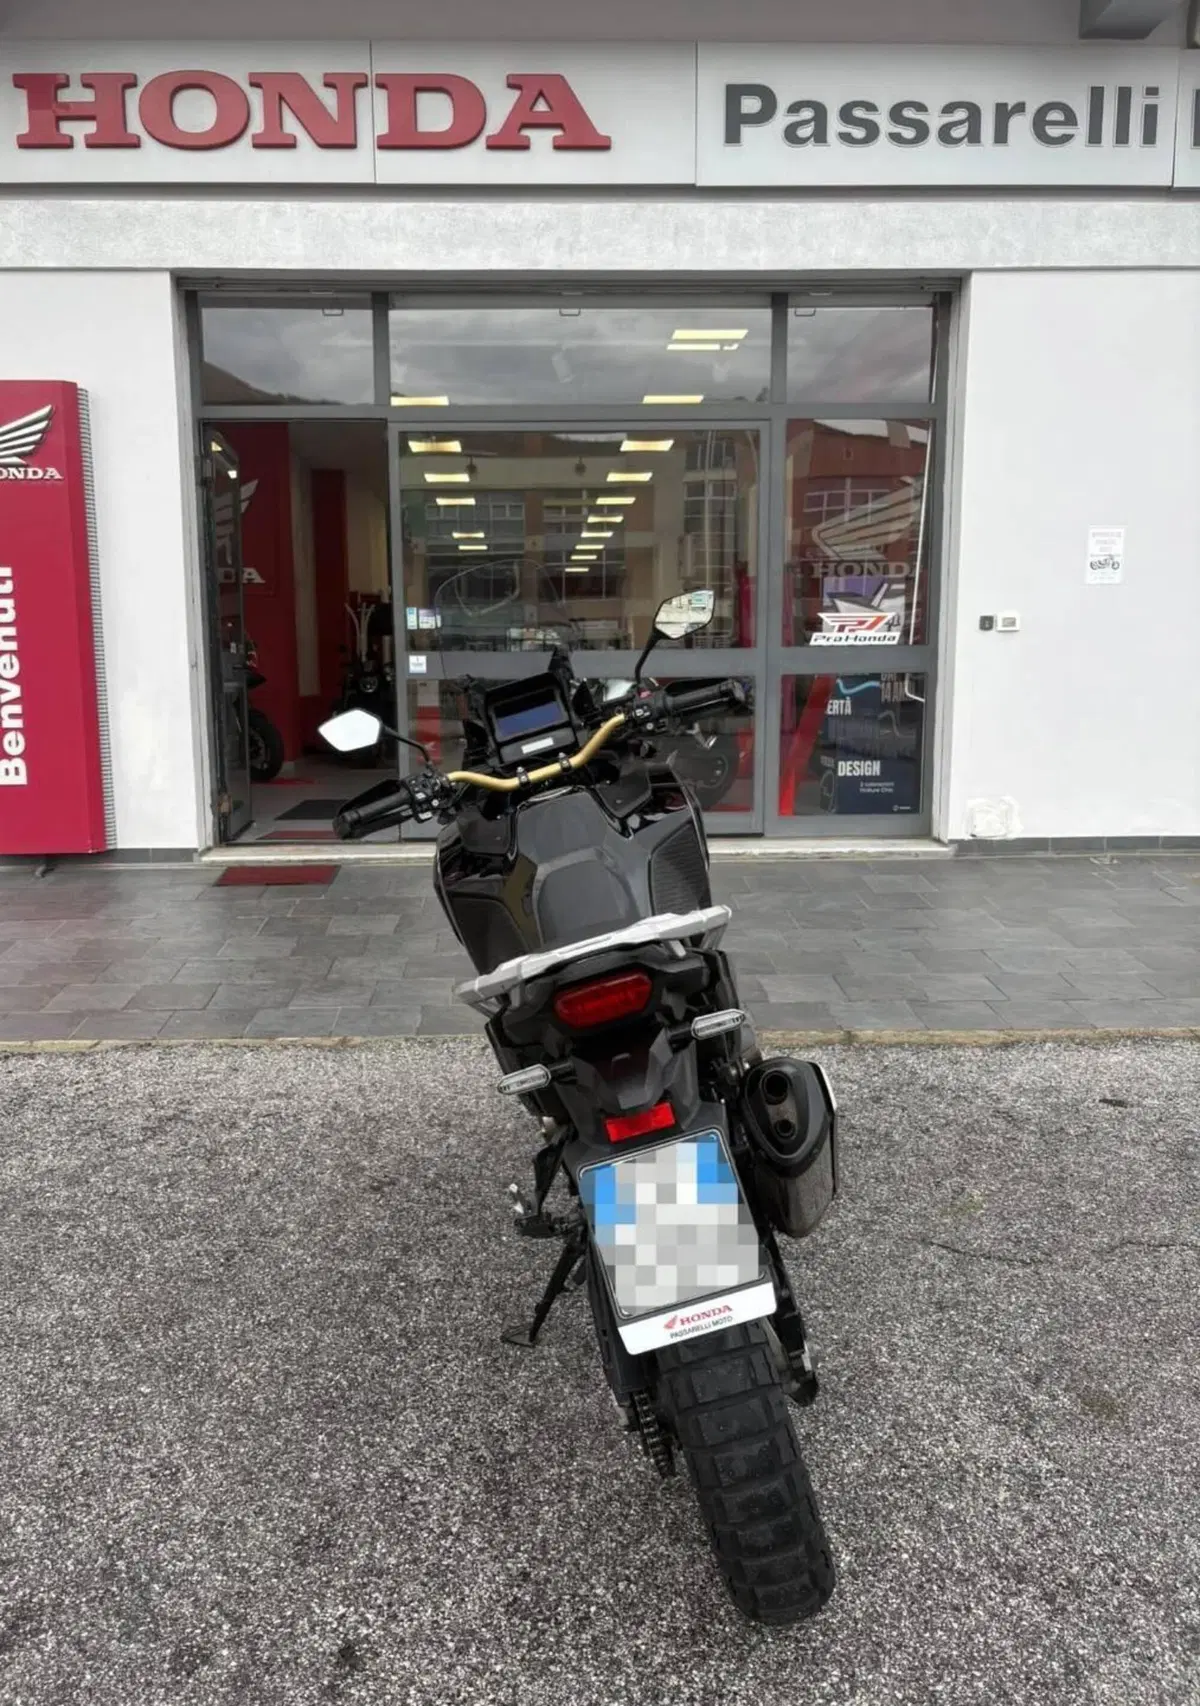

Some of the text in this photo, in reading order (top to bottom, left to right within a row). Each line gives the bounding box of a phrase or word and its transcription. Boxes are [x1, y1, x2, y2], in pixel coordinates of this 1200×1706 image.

[12, 70, 612, 150] HONDA
[724, 83, 1161, 148] Passarelli
[0, 467, 64, 480] ONDA
[826, 696, 852, 715] ERTÀ
[837, 760, 881, 777] DESIGN
[680, 1305, 733, 1325] HONDA
[670, 1315, 733, 1338] PASSARELLI MOTO
